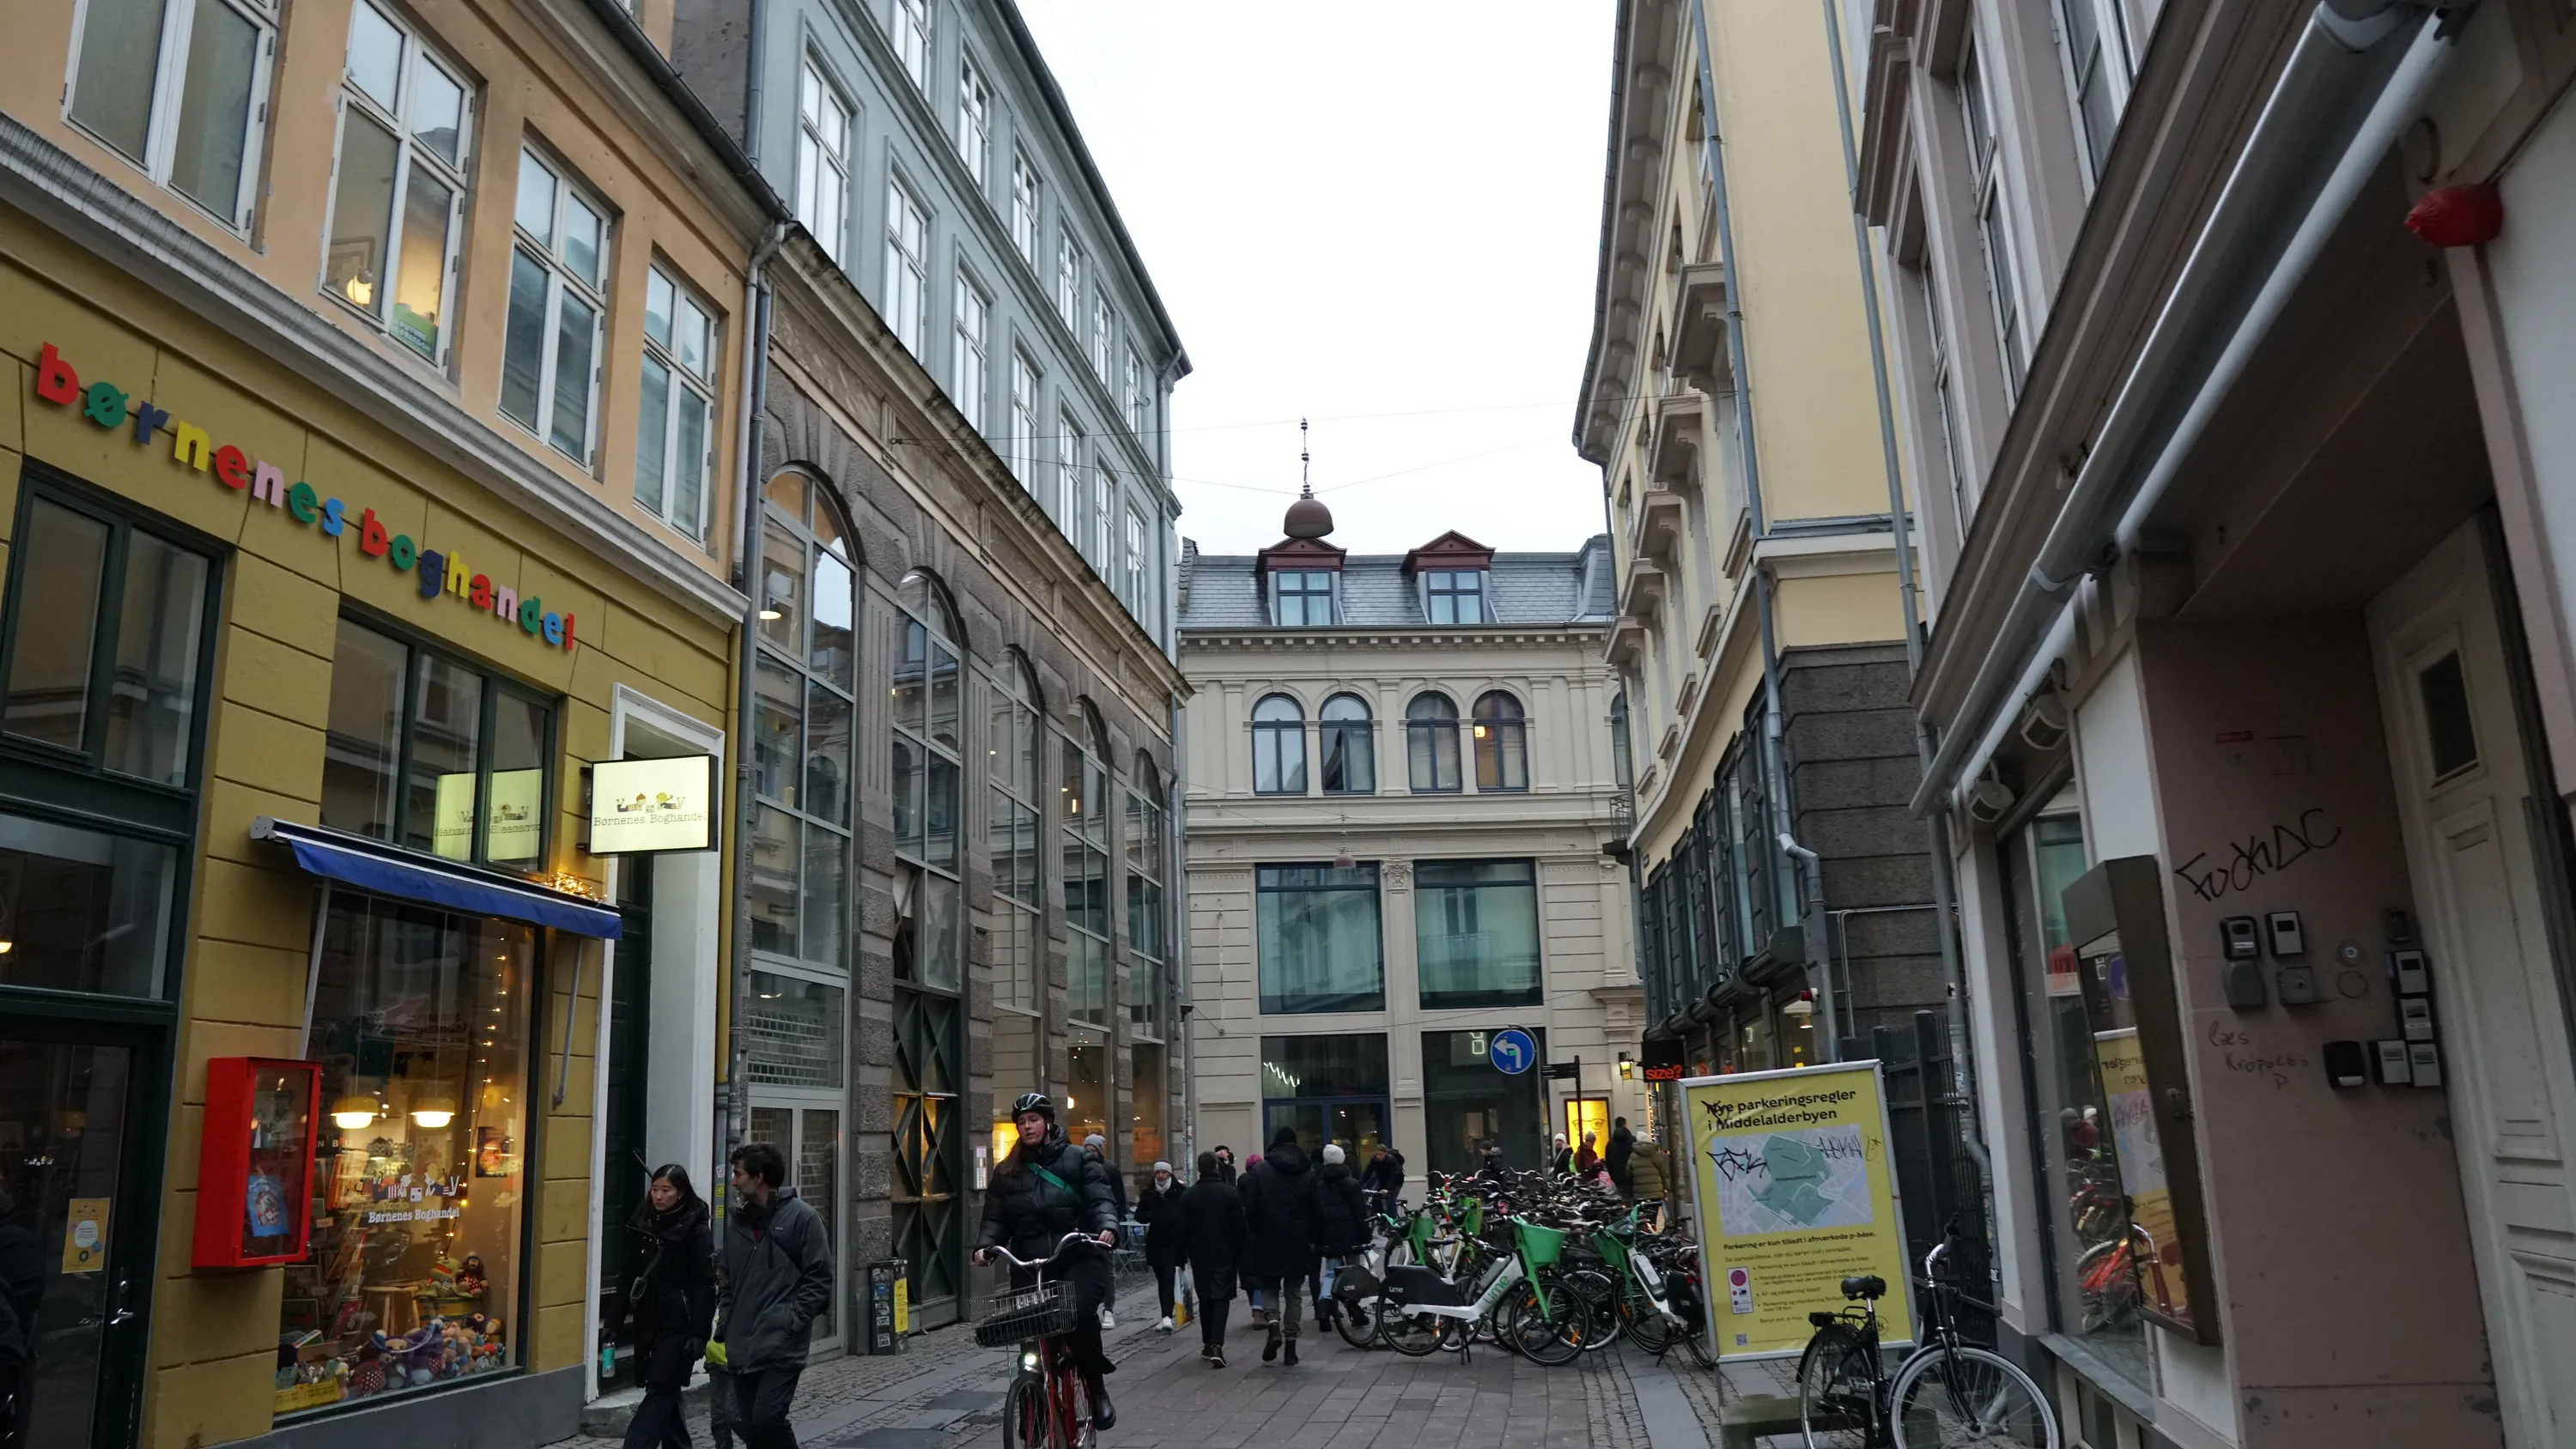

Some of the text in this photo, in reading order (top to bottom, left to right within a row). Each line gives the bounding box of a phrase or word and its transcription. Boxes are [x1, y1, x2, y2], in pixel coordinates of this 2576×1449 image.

[37, 342, 575, 651] børnenes boghandel
[593, 811, 707, 827] Børnenes Boghandel
[1646, 1064, 1683, 1080] size?
[1737, 1090, 1856, 1113] parkeringsregler
[1708, 1108, 1838, 1131] i Middelalderbyen
[368, 1207, 460, 1223] Børnenes Boghandel
